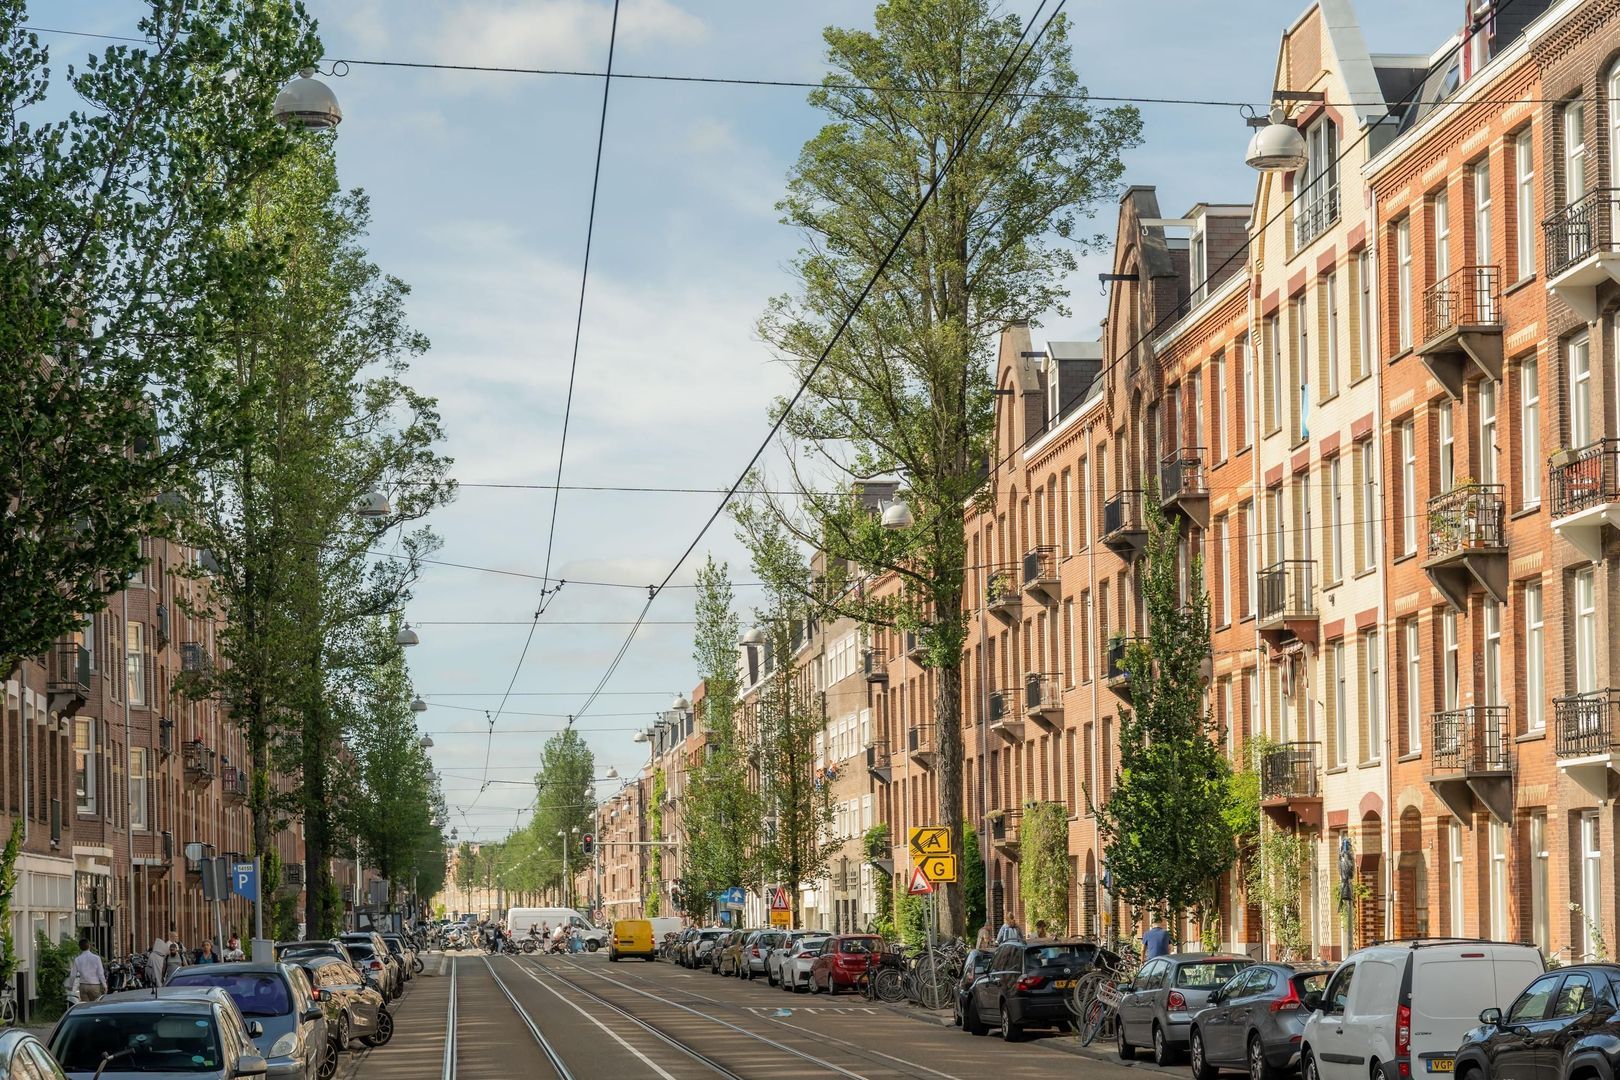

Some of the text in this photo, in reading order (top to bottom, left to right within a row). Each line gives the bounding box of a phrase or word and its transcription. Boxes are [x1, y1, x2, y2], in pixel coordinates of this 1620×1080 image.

[928, 834, 940, 848] A
[933, 862, 945, 876] G
[239, 874, 249, 889] P
[1433, 1061, 1452, 1070] VGP
